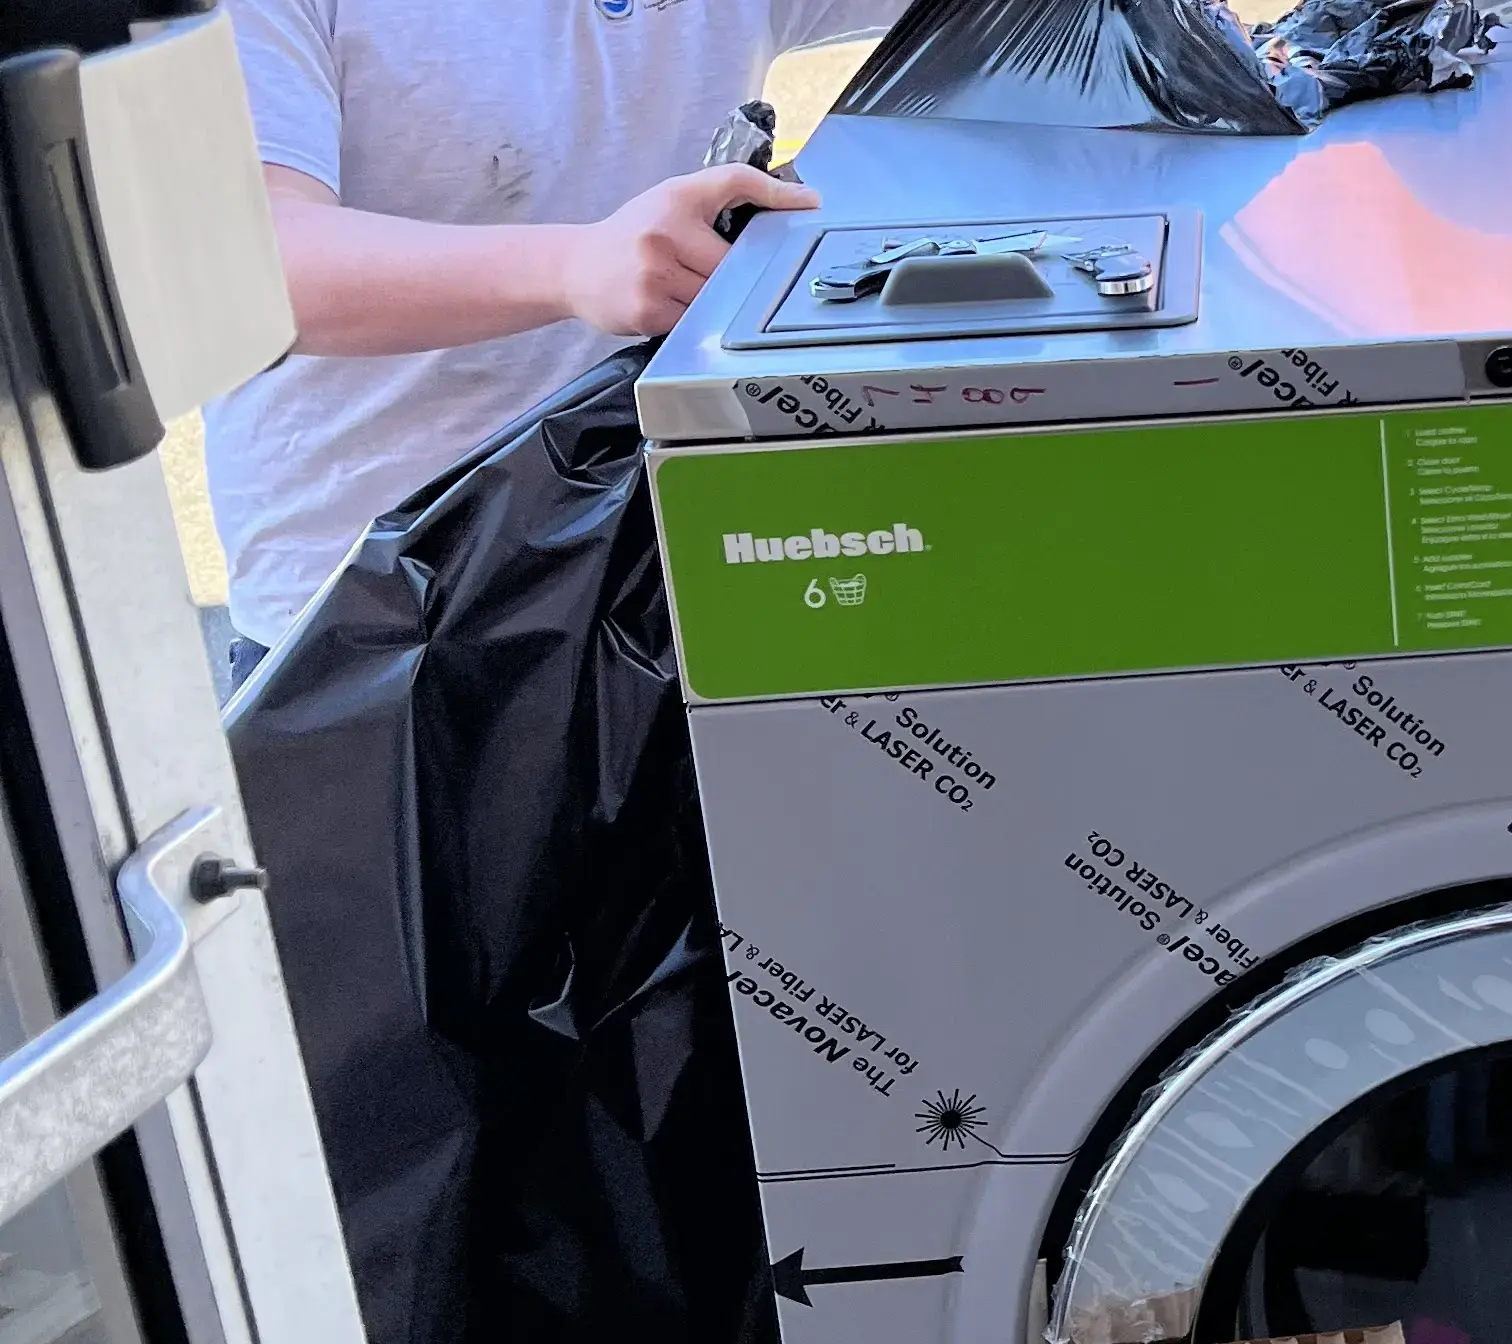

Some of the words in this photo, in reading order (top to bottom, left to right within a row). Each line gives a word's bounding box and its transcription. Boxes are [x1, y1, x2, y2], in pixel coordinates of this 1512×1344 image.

[722, 523, 924, 564] Huebsch
[804, 578, 826, 609] 6
[1303, 680, 1317, 696] &
[1318, 688, 1386, 748] LASER
[1352, 675, 1444, 756] Solution
[844, 711, 859, 729] &
[861, 720, 933, 780] LASER
[896, 708, 996, 789] Solution
[1065, 853, 1160, 930] Solution
[1126, 862, 1194, 918] LASER
[1194, 908, 1208, 924] &
[746, 944, 760, 960] &
[757, 958, 816, 1002] Fiber
[816, 996, 886, 1051] LASER
[853, 1057, 895, 1097] The
[884, 1048, 919, 1074] for
